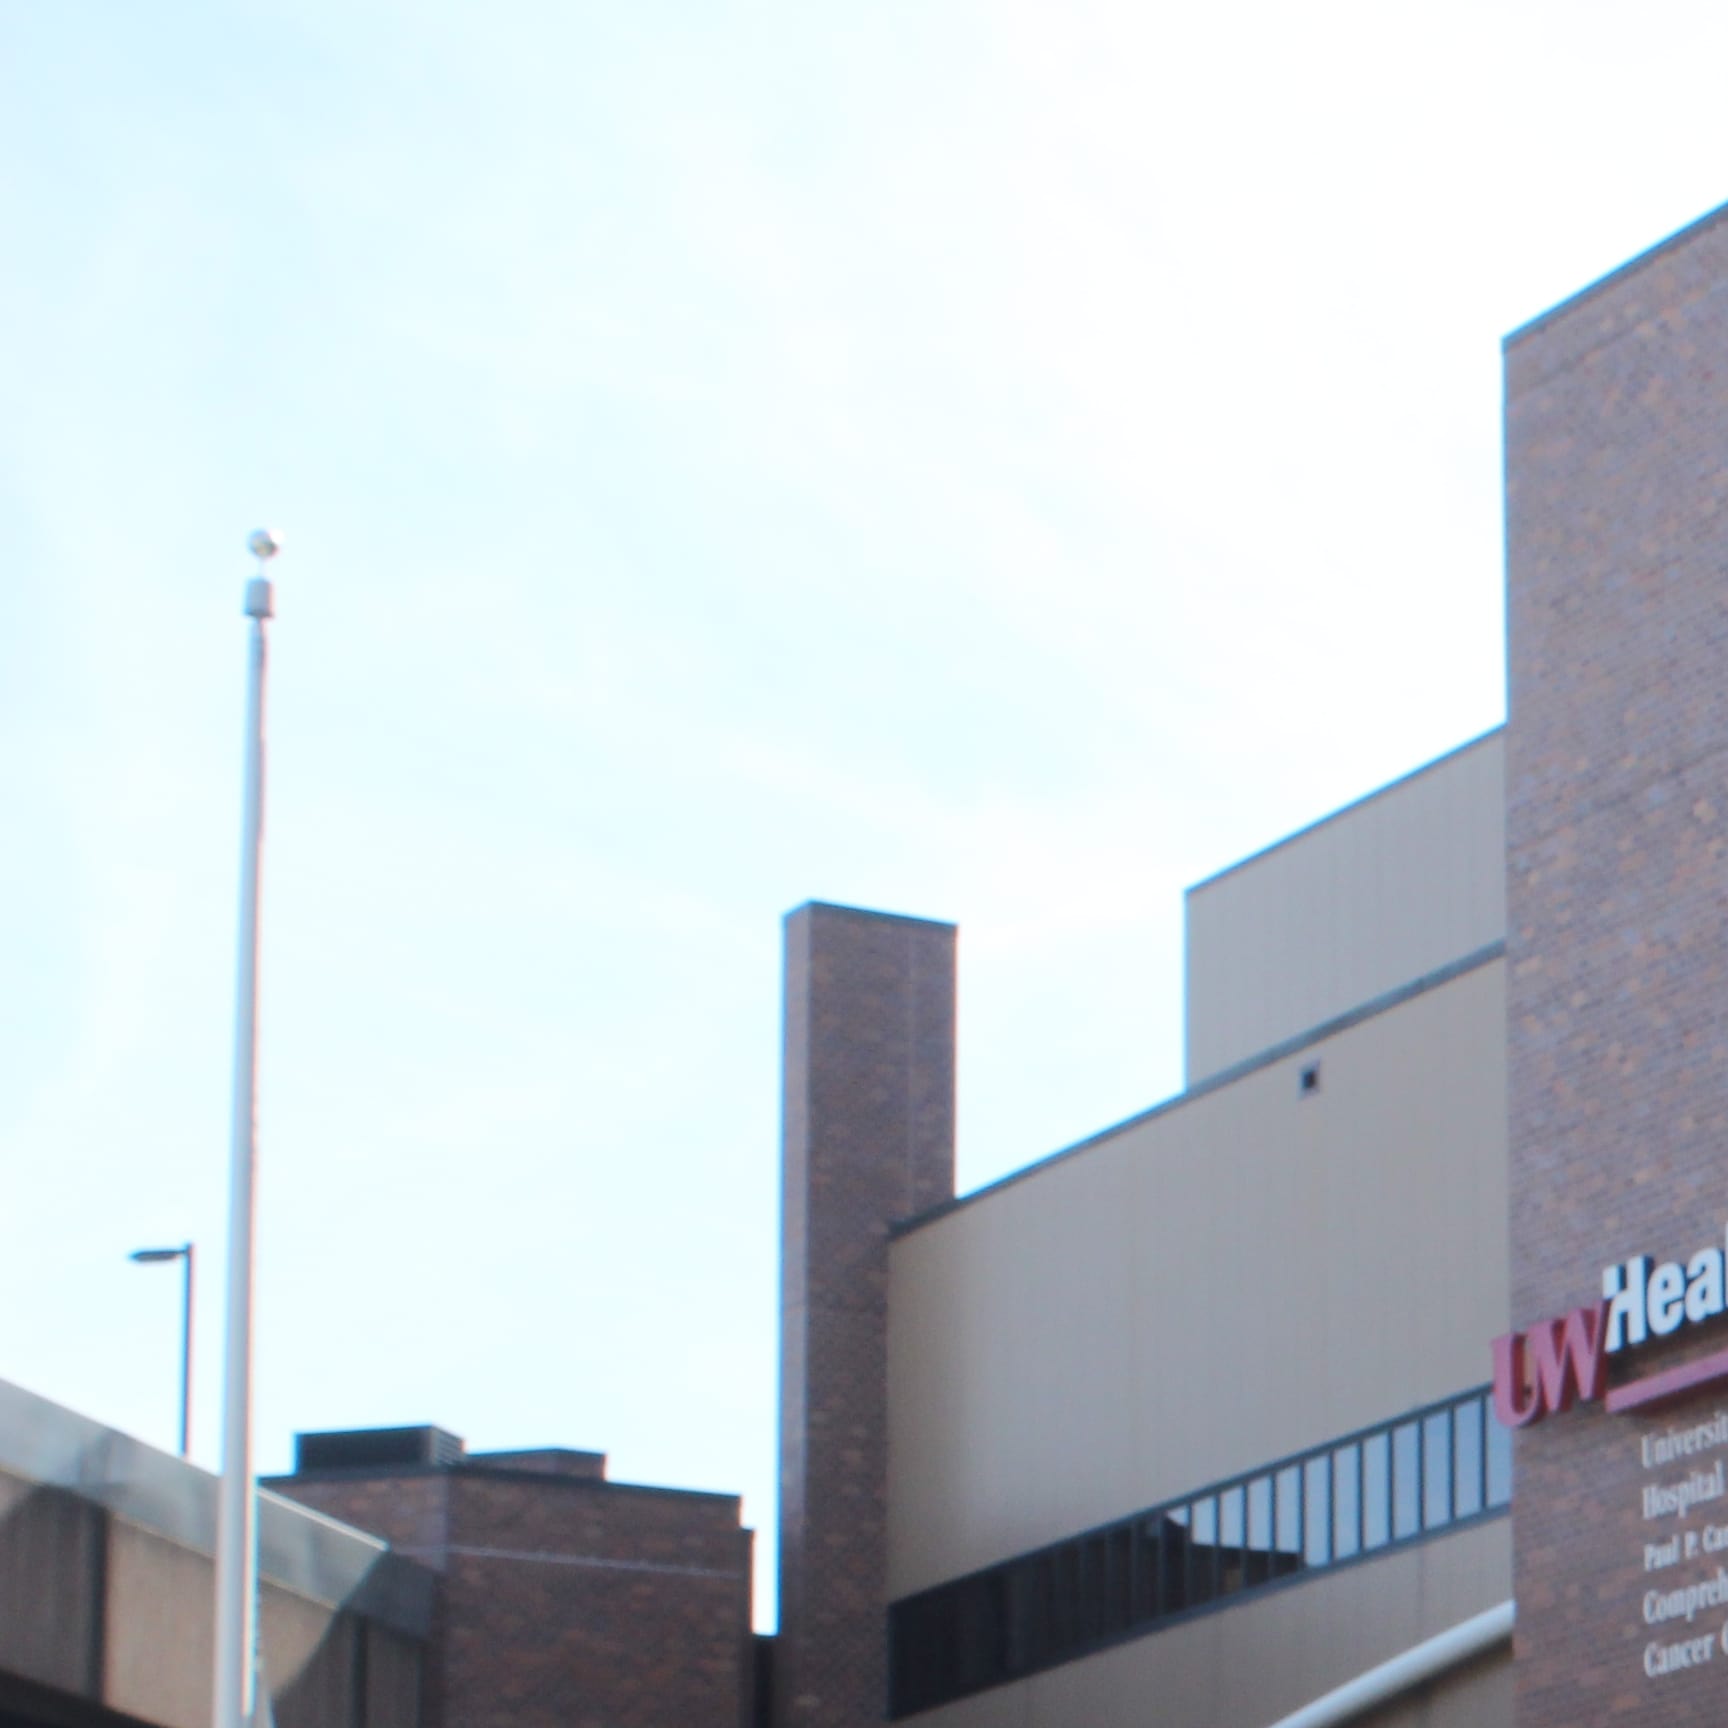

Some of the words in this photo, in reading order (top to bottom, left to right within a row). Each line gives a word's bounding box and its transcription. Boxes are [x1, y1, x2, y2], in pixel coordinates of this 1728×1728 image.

[1491, 1306, 1606, 1427] UW
[1642, 1459, 1724, 1520] Hospital
[1644, 1536, 1680, 1572] Paul
[1643, 1630, 1715, 1678] Cancer
